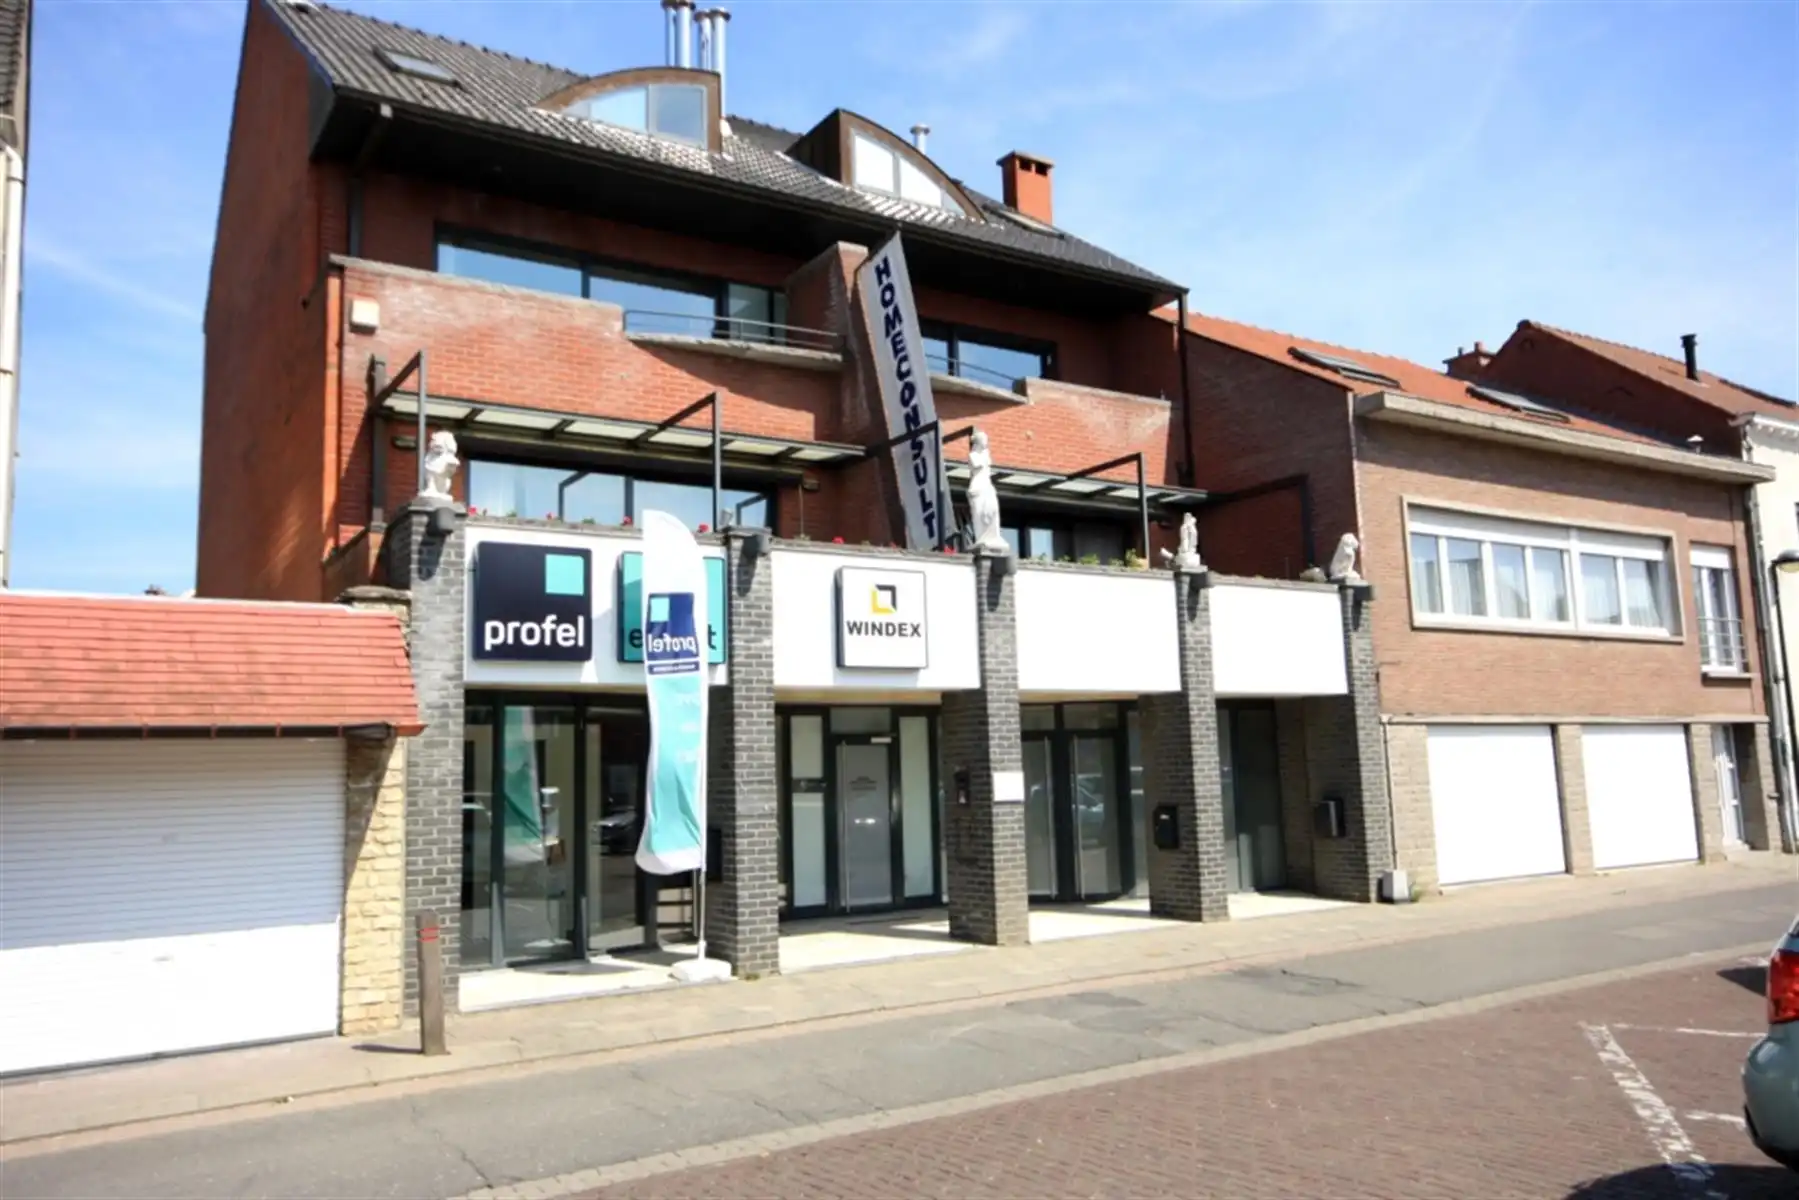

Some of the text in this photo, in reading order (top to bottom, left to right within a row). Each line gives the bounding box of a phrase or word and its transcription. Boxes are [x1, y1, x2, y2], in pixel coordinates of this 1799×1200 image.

[874, 255, 936, 540] HOMECONSULT
[484, 614, 585, 651] profel
[846, 620, 922, 638] WINDEX
